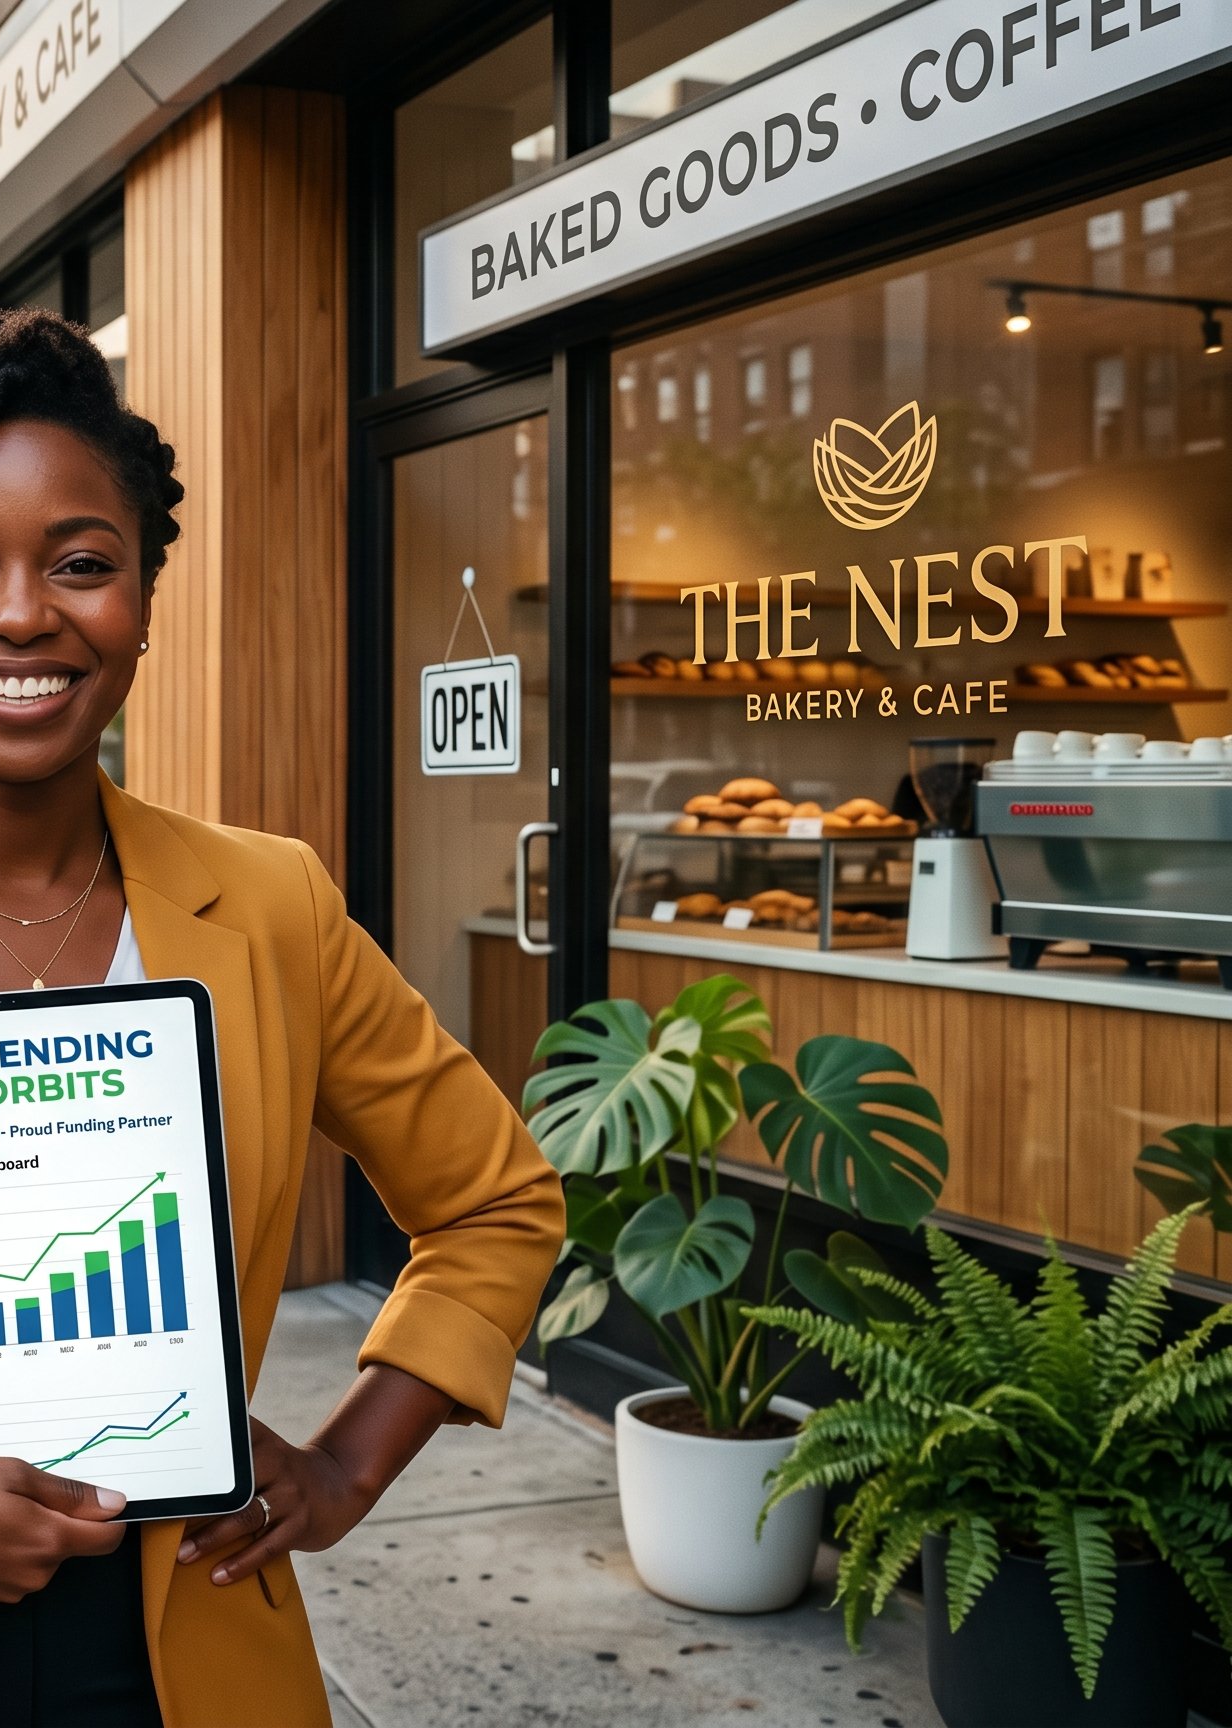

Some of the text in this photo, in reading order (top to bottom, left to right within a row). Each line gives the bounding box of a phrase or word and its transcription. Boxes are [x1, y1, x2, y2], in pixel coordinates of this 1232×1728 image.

[14, 65, 28, 130] &
[471, 190, 621, 300] BAKED
[639, 92, 839, 229] GOODS
[680, 535, 1088, 665] THE NEST
[432, 680, 508, 753] OPEN
[746, 680, 1008, 722] BAKERY & CAFE
[9, 1122, 53, 1138] Proud
[56, 1119, 115, 1134] Funding
[118, 1115, 173, 1130] Partner
